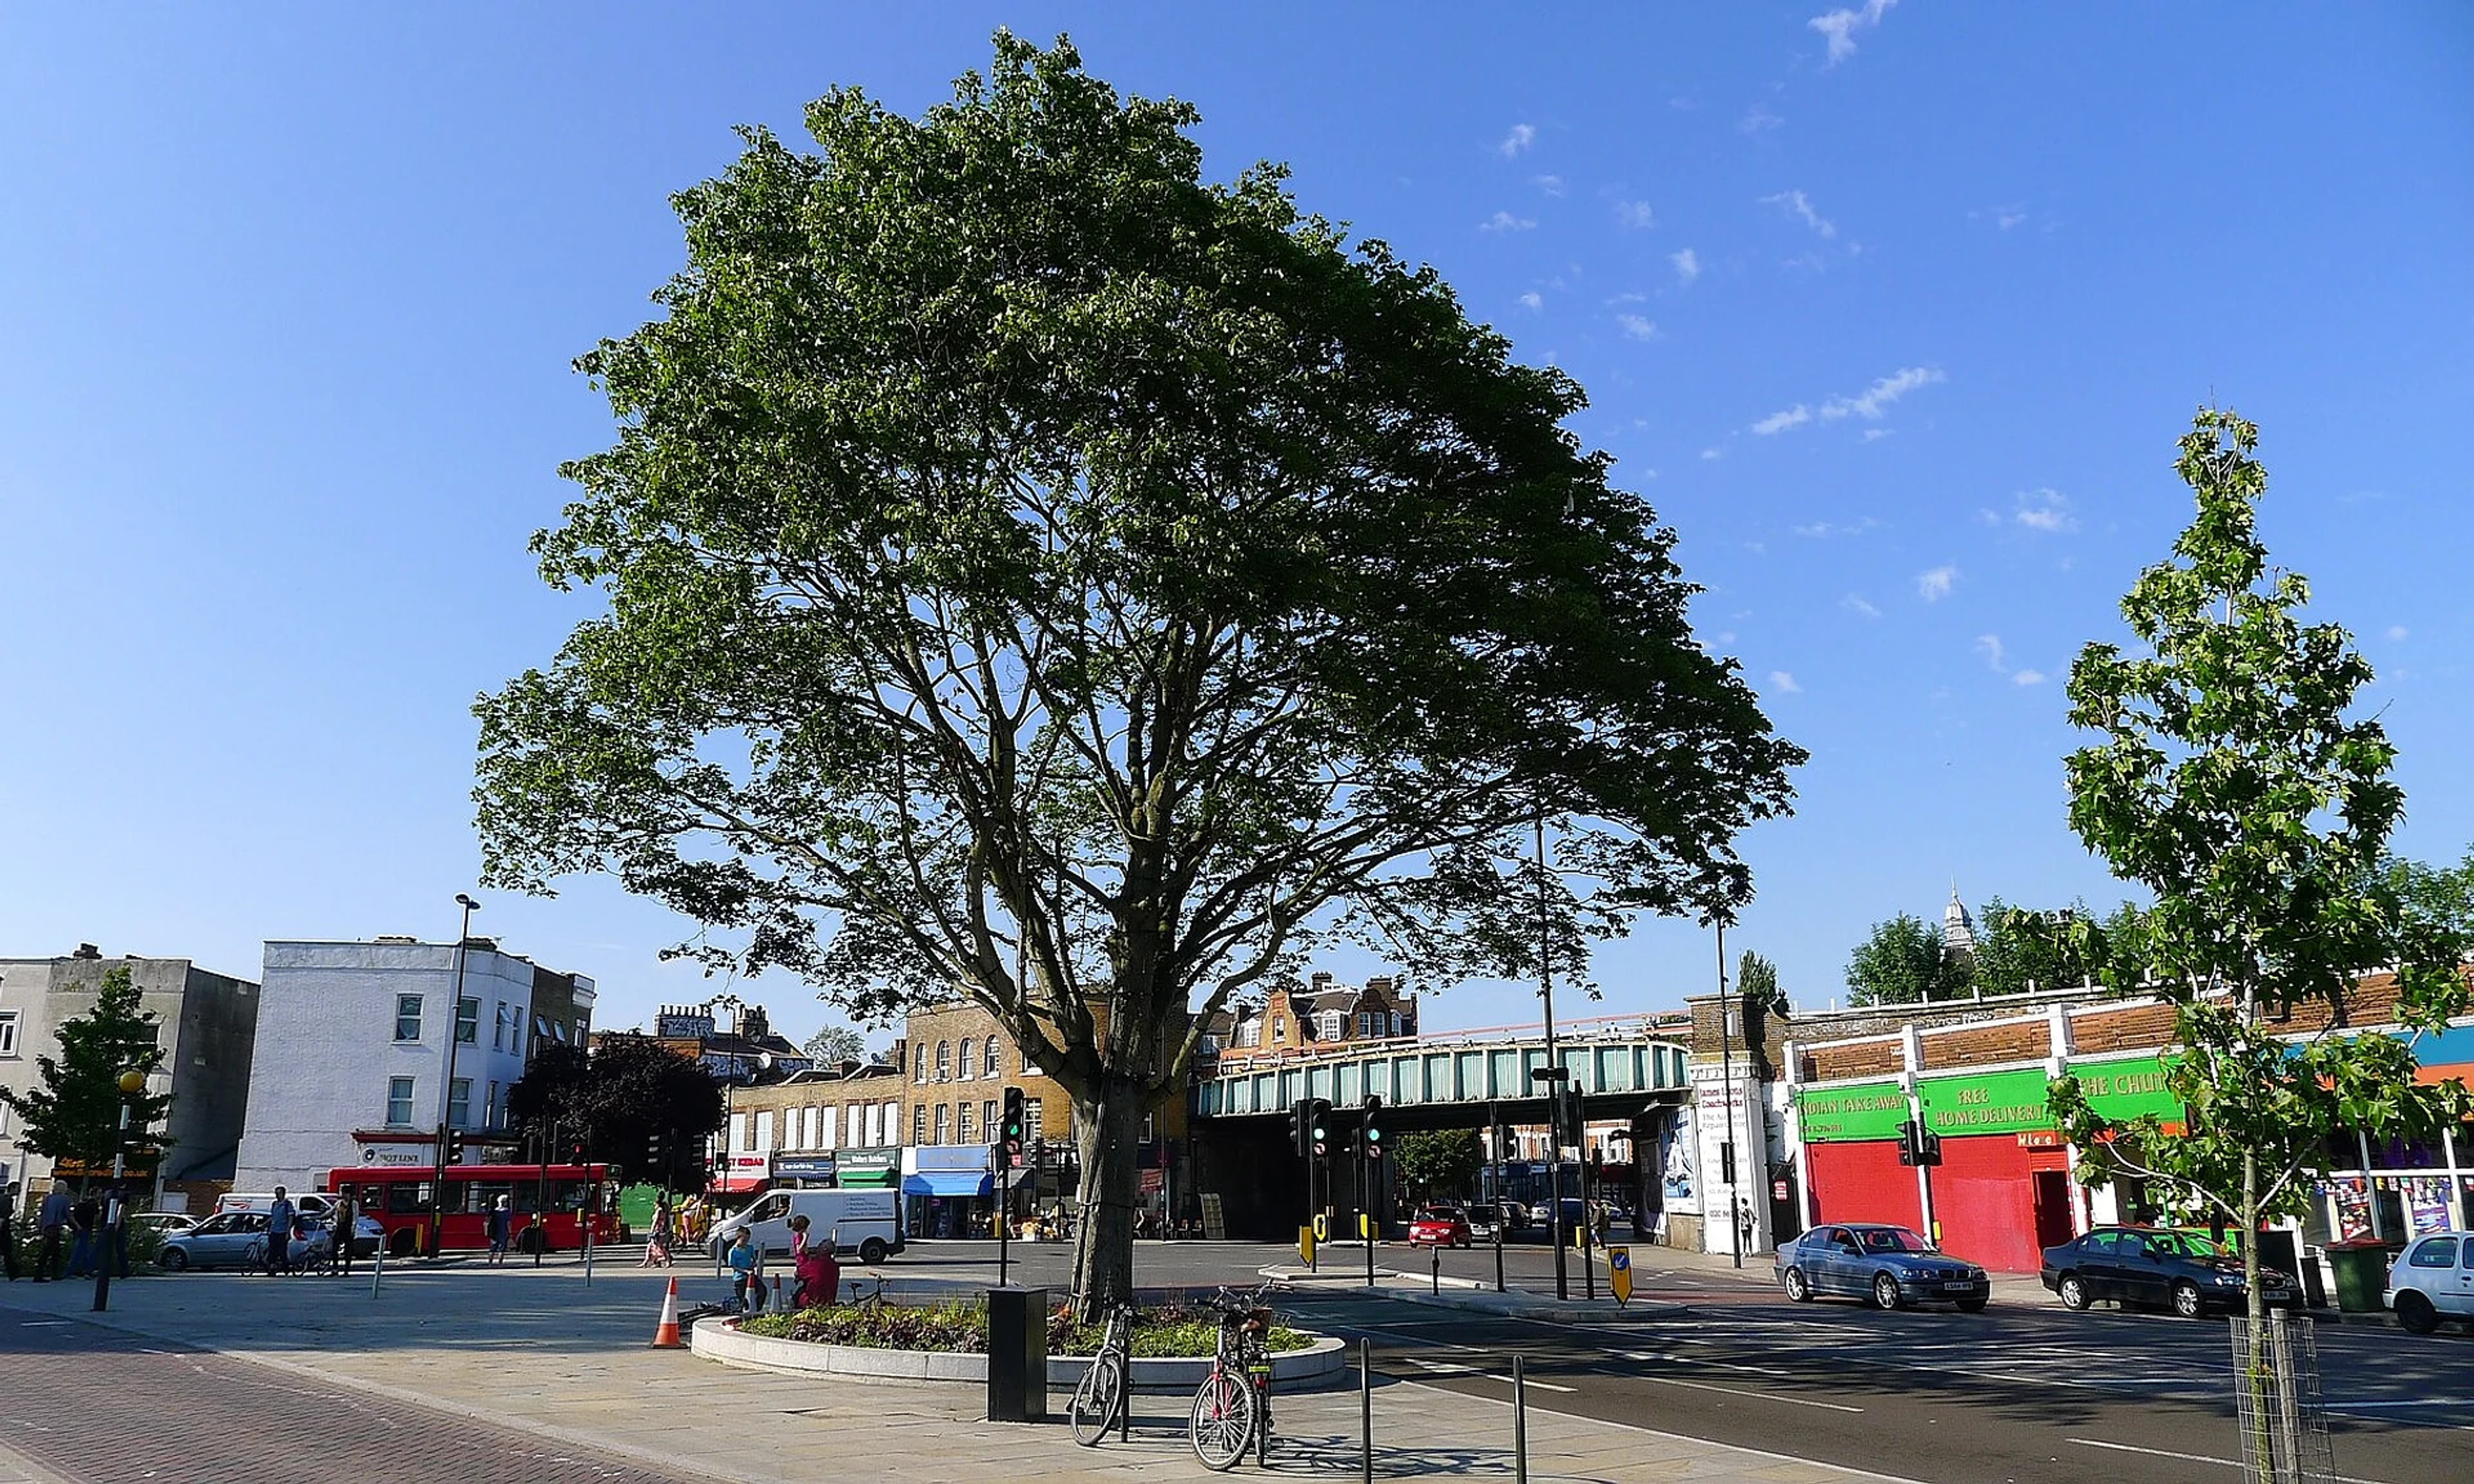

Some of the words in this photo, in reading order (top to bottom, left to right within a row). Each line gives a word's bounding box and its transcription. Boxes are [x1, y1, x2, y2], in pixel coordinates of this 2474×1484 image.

[1721, 1087, 1743, 1096] Lons
[1957, 1089, 1989, 1105] FREE
[1702, 1098, 1743, 1108] Coachwrks
[1799, 1100, 1838, 1116] INDIAN
[1935, 1109, 1977, 1127] HOME
[1979, 1105, 2044, 1124] DELIVERY
